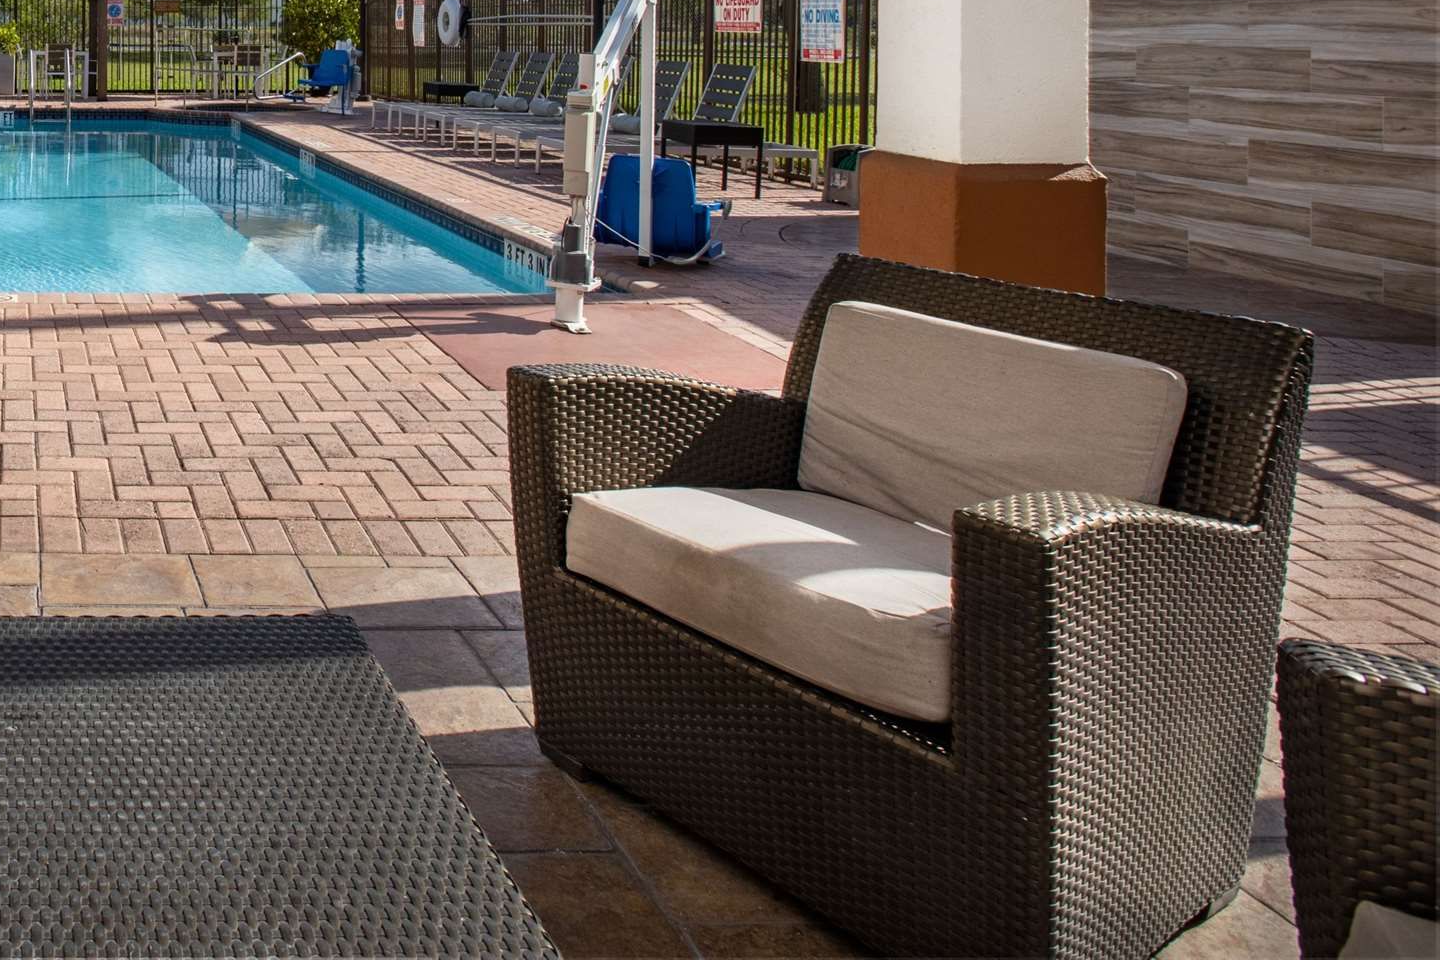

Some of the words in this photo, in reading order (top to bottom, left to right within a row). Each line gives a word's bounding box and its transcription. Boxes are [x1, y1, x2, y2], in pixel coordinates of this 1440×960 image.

[723, 7, 731, 21] ON
[733, 7, 750, 21] DUTY
[804, 9, 814, 23] NO
[815, 9, 840, 23] DIVING
[506, 243, 512, 261] 3
[515, 247, 525, 265] FT
[527, 253, 534, 270] 3
